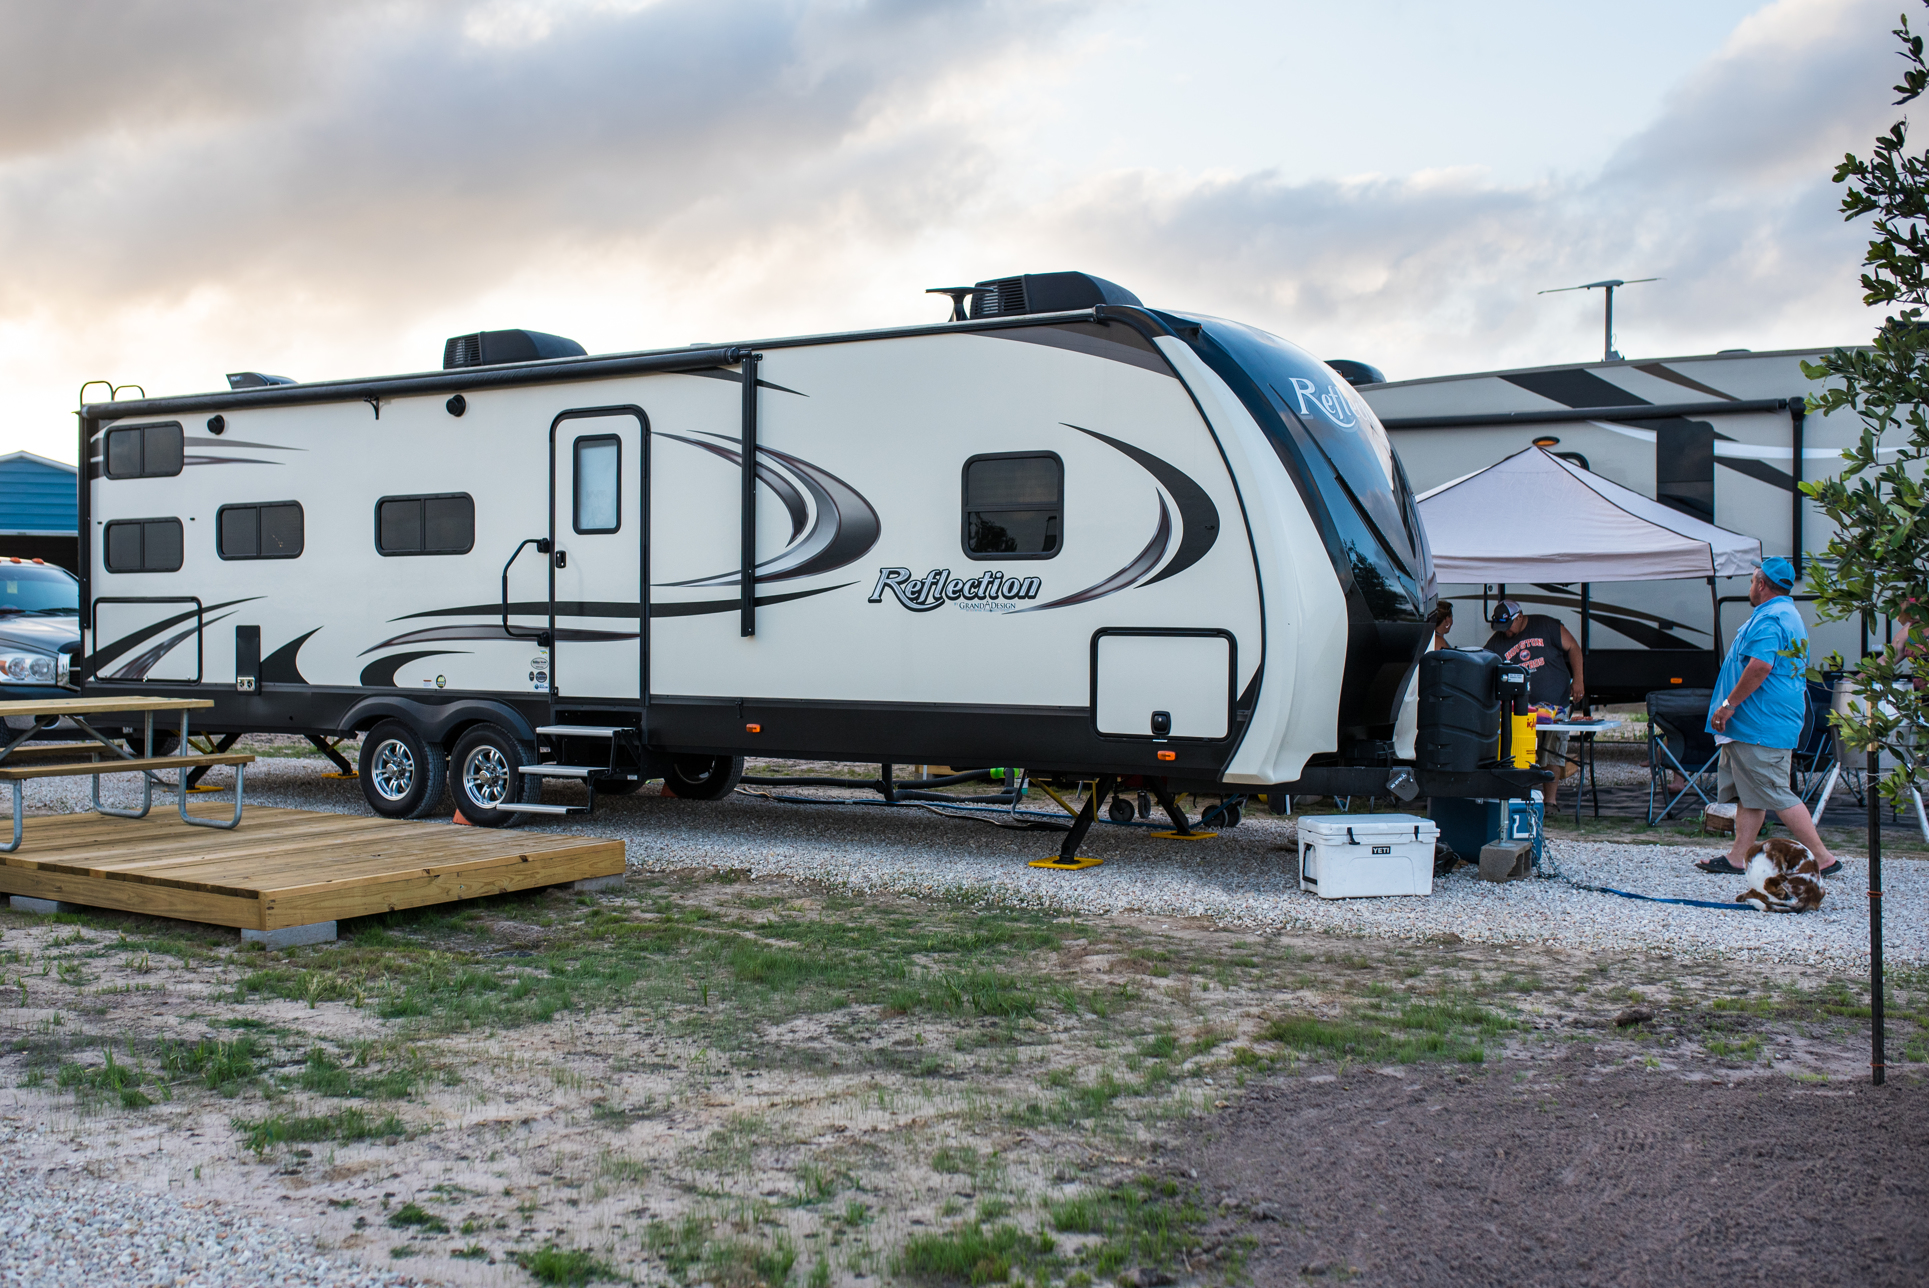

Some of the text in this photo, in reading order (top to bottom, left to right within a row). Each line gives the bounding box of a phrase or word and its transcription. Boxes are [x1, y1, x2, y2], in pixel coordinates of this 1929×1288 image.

[868, 567, 1042, 612] Reflection
[990, 601, 1016, 610] DESIGN
[1504, 638, 1544, 660] HOUSTON
